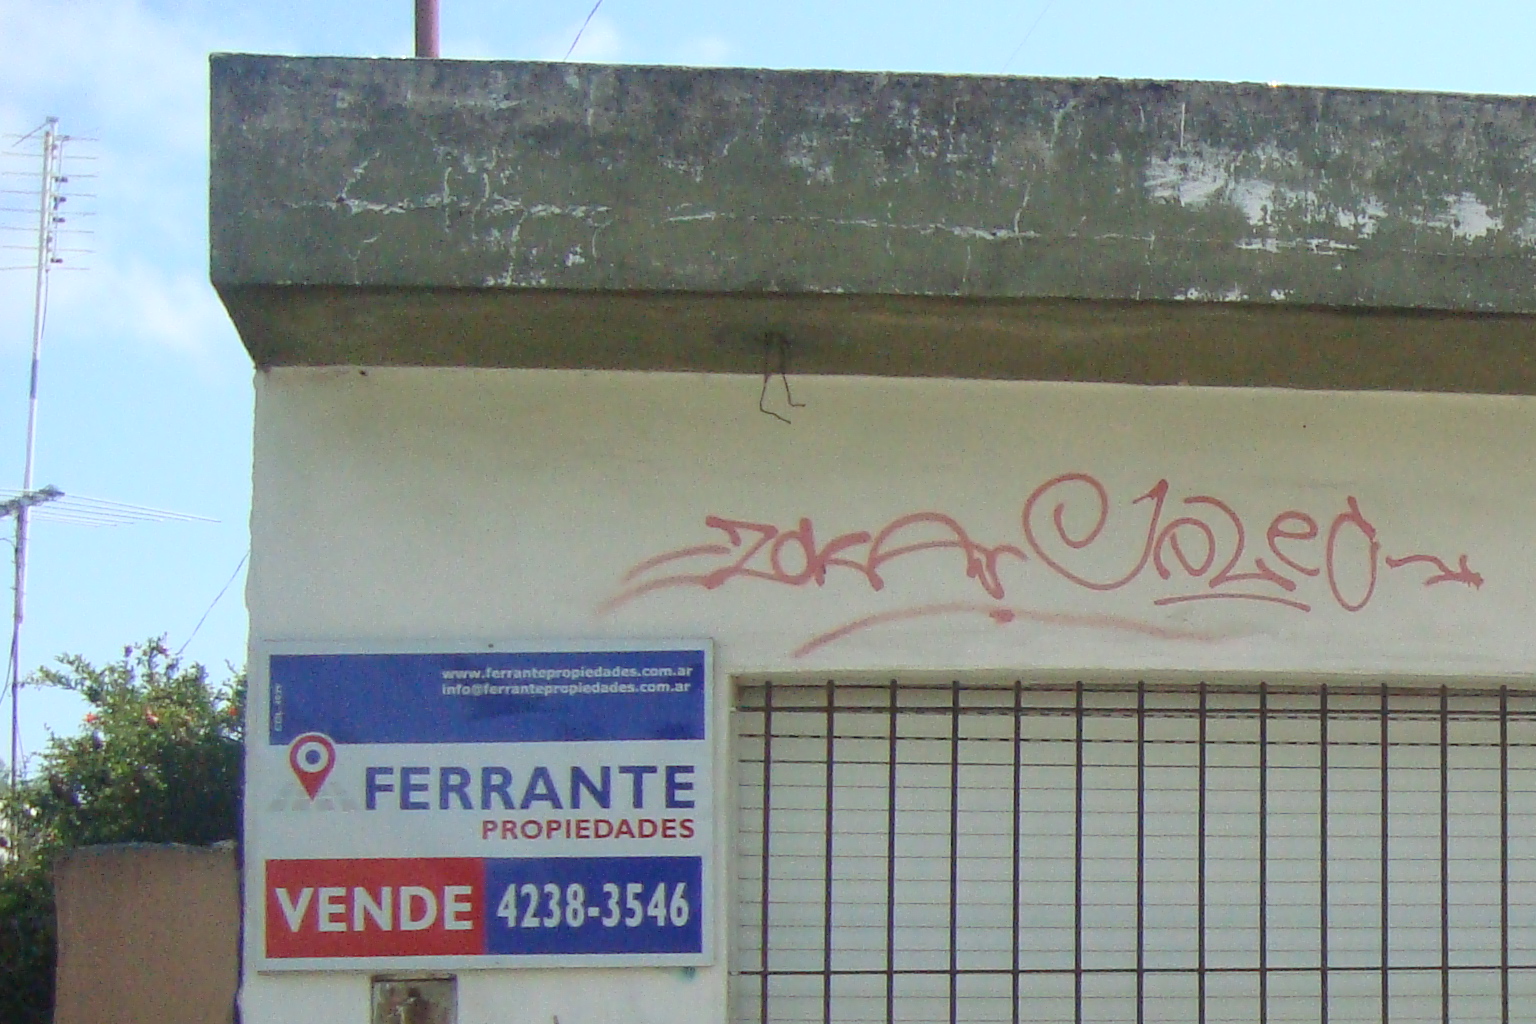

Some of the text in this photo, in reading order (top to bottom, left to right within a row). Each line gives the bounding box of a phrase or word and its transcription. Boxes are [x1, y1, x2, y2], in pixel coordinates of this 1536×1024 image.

[441, 666, 693, 681] www.ferrantepropiedades.com.ar
[441, 681, 691, 696] info@ferrantepropiedades.com.ar
[365, 765, 696, 811] FERRANTE
[481, 818, 695, 841] PROPIEDADES
[275, 881, 690, 933] VENDE 4238-3546
